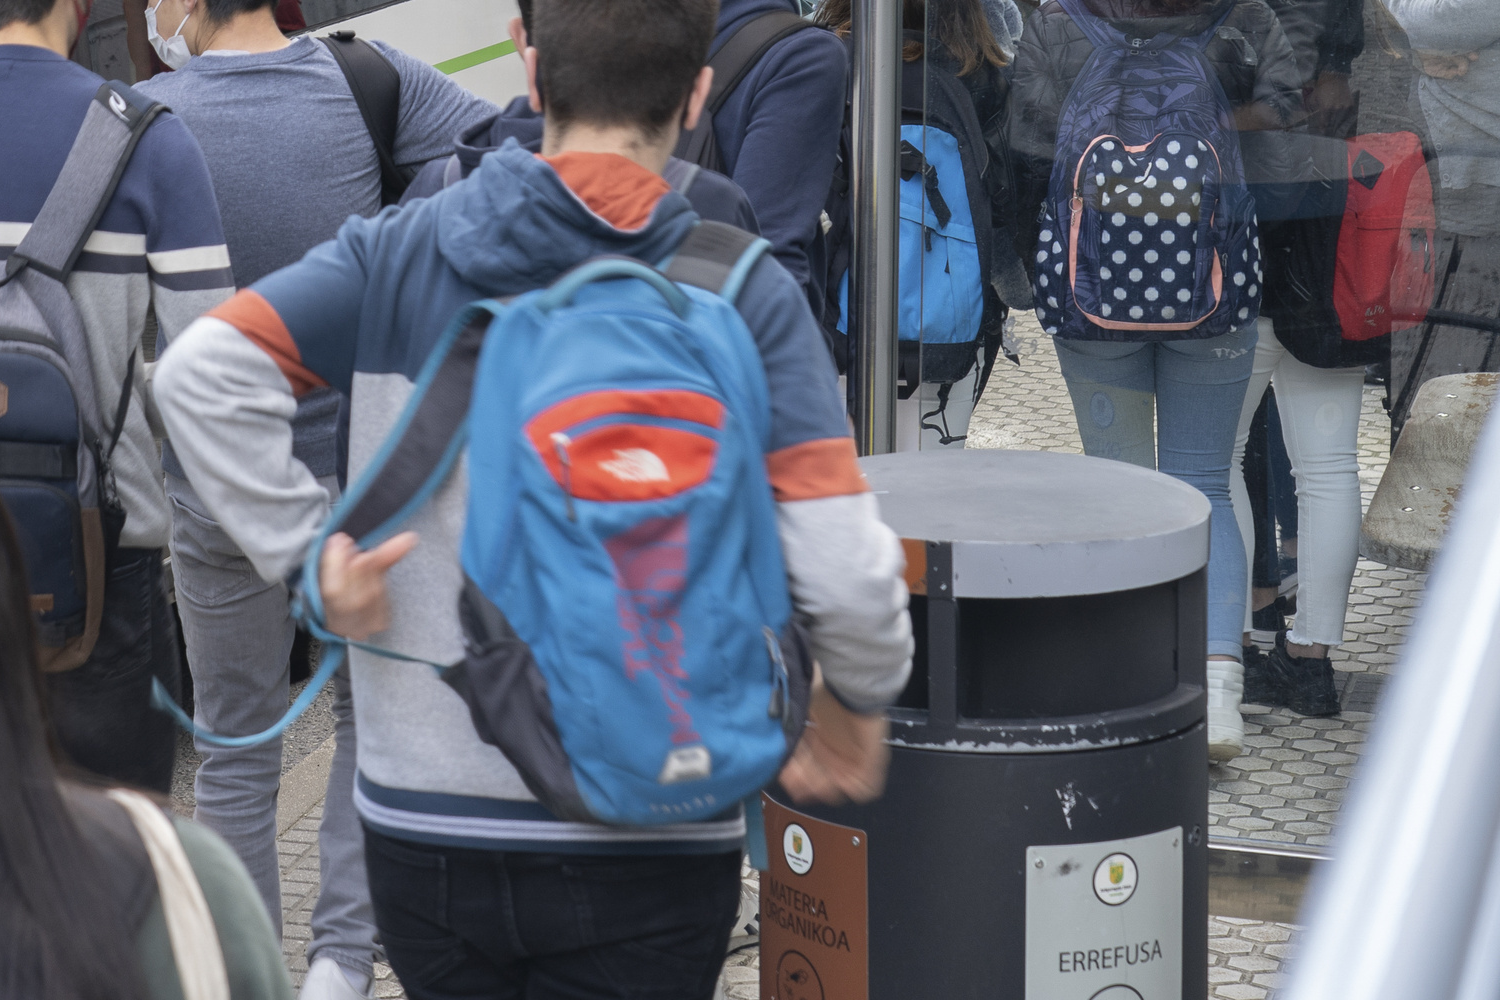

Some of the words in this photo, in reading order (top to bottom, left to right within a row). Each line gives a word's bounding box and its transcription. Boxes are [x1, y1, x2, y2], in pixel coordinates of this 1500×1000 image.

[769, 877, 828, 921] MATERIA
[764, 897, 851, 952] ORGANIKOA
[1059, 939, 1163, 973] ERREFUSA
